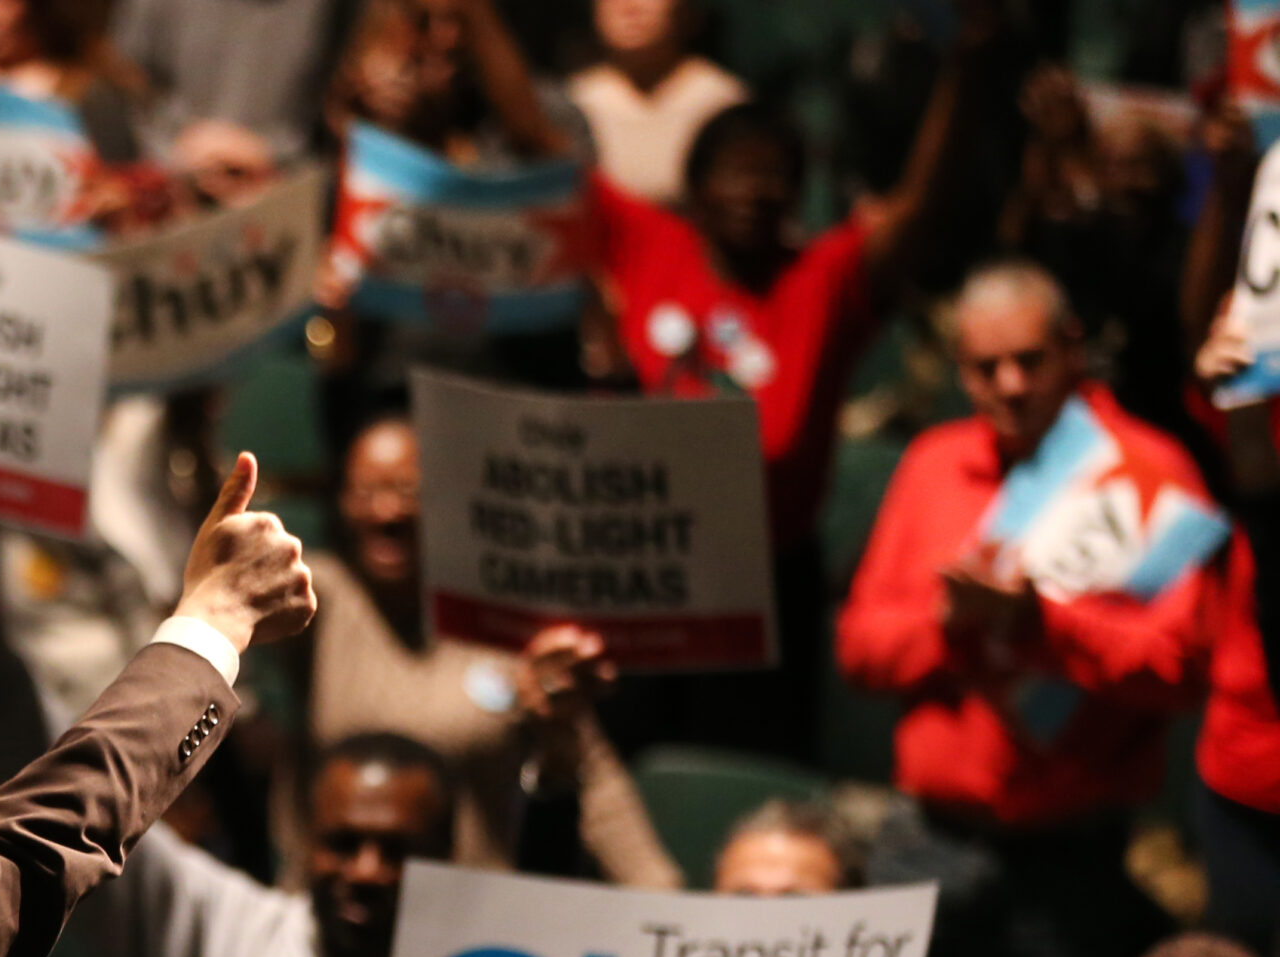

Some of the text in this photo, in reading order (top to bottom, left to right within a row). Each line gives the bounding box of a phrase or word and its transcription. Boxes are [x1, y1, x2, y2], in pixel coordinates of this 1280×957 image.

[481, 448, 670, 505] ABOLISH
[469, 495, 694, 556] RED-LIGHT
[479, 548, 689, 608] CAMERAS
